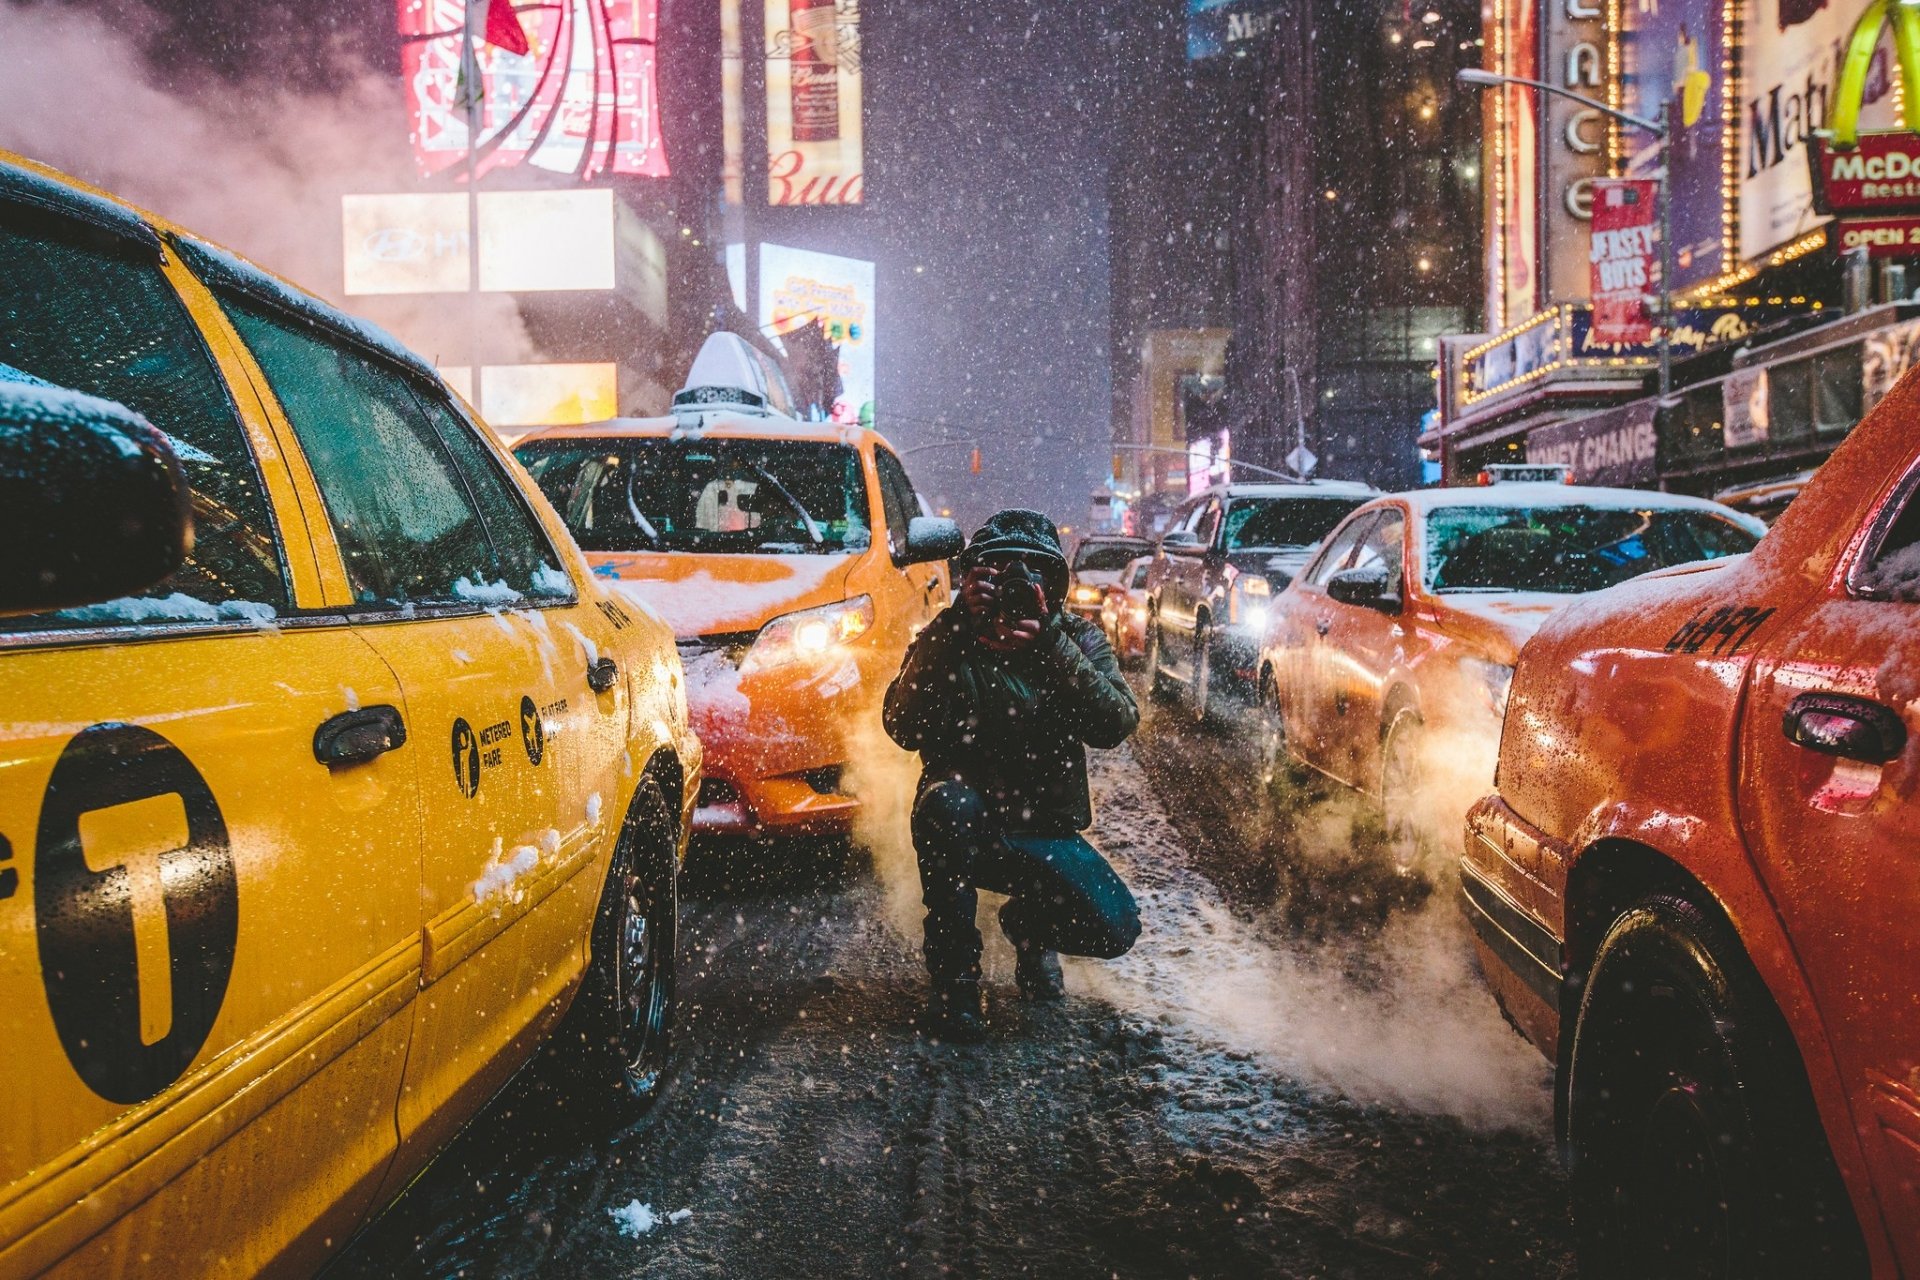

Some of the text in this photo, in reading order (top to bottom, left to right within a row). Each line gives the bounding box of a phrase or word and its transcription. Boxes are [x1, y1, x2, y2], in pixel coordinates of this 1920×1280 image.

[1590, 224, 1653, 263] JERSEY
[1843, 227, 1904, 247] OPEN
[1600, 256, 1647, 292] BOYS
[479, 720, 512, 747] METERED
[483, 747, 502, 768] FARE
[77, 791, 190, 1046] T
